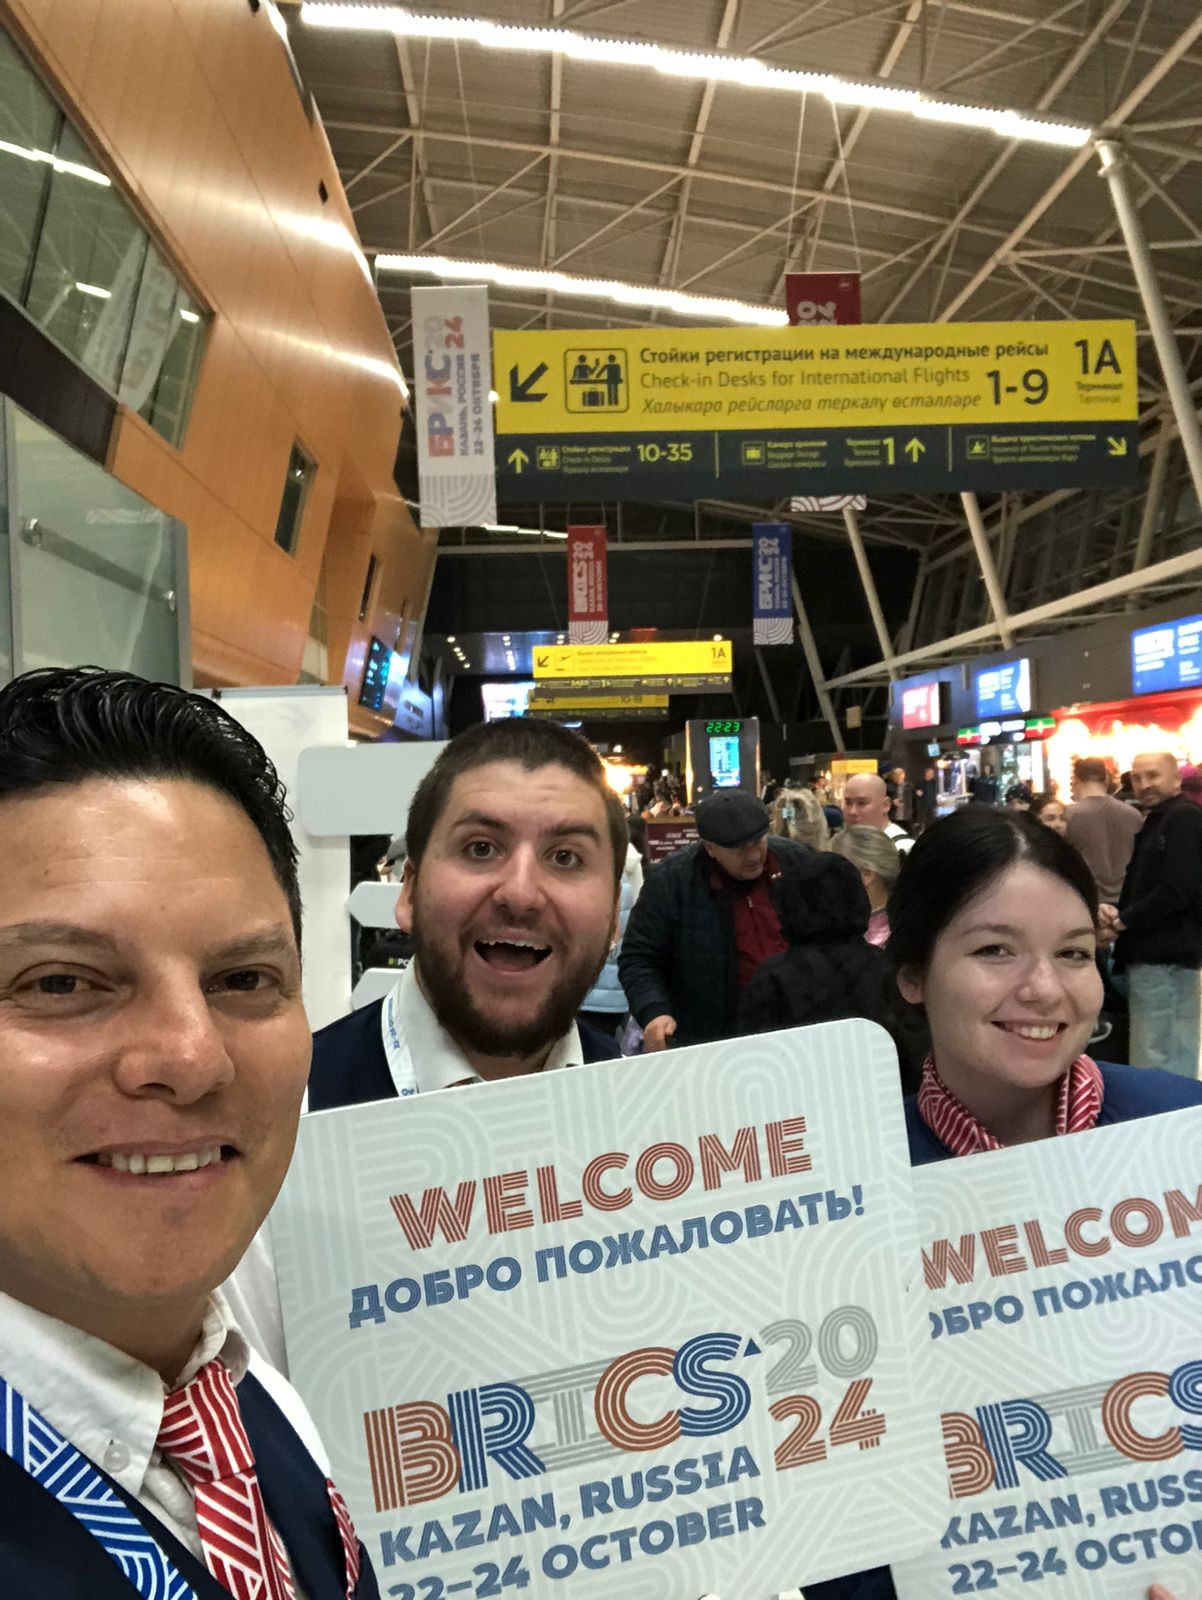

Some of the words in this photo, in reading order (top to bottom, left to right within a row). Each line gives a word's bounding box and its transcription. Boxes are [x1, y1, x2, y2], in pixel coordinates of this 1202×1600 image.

[640, 347, 699, 365] Стойки
[705, 346, 814, 366] регистрации
[819, 347, 840, 361] на
[845, 344, 990, 362] международные
[996, 341, 1049, 360] рейсы
[640, 371, 713, 389] Check-in
[718, 371, 767, 387] Desks
[772, 370, 794, 386] for
[801, 368, 908, 386] International
[914, 366, 971, 386] Flights
[1073, 338, 1122, 375] 1A
[641, 397, 723, 416] Халыкара
[728, 396, 812, 414] рейсларга
[986, 368, 1049, 405] 1-9
[637, 443, 693, 463] 10-35
[882, 437, 895, 466] 1
[389, 1116, 813, 1251] WELCOME
[348, 1256, 522, 1330] ДОБРО
[534, 1184, 865, 1283] ПОЖАЛОВАТЬ!
[921, 1184, 1202, 1291] WELCOM
[362, 1332, 752, 1513] BRICS
[758, 1304, 879, 1396] 20
[767, 1377, 887, 1472] 24
[379, 1492, 571, 1568] KAZAN,
[579, 1445, 761, 1518] RUSSIA
[541, 1497, 767, 1579] OCTOBER
